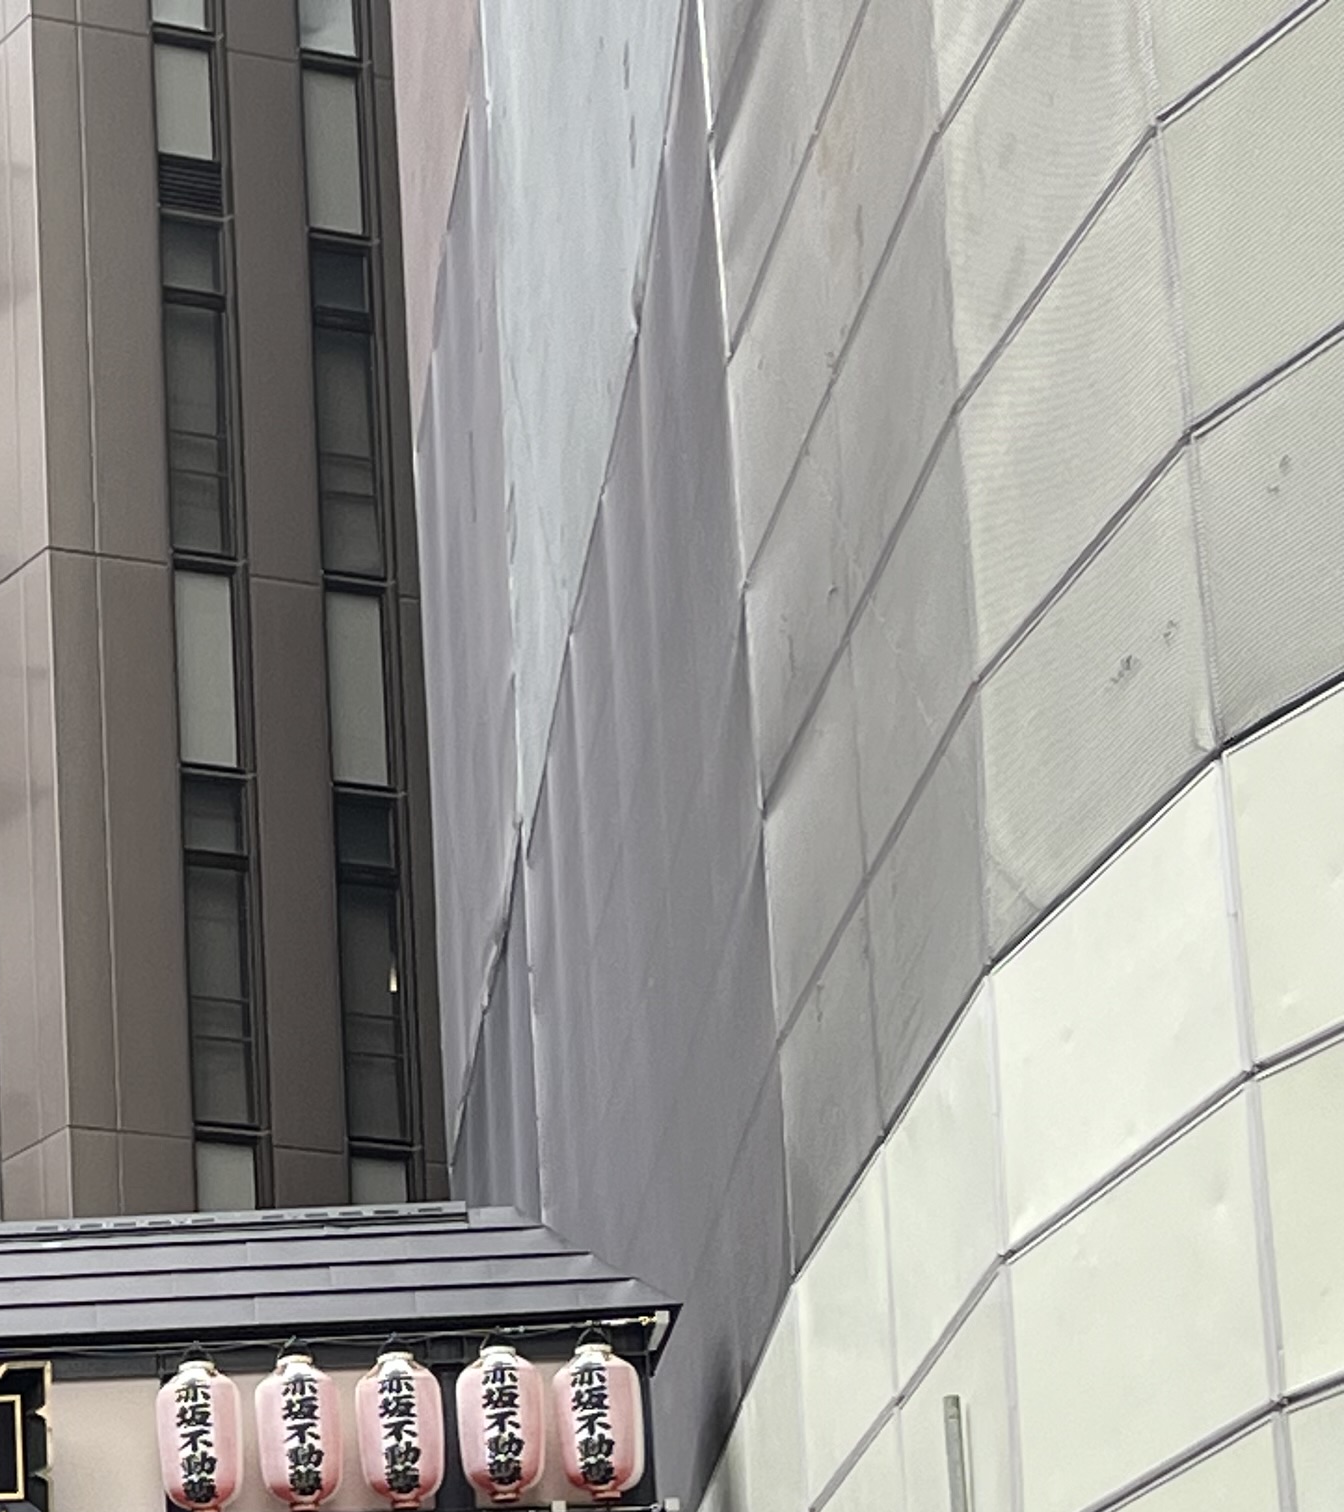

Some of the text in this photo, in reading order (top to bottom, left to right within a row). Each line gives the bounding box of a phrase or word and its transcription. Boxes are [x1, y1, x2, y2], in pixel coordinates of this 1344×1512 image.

[175, 1378, 219, 1501] 赤坂不動尊
[282, 1372, 323, 1495] 赤坂不動尊
[378, 1369, 420, 1492] 赤坂不動尊
[482, 1361, 524, 1485] 赤坂不動尊
[571, 1361, 616, 1485] 赤坂不動尊
